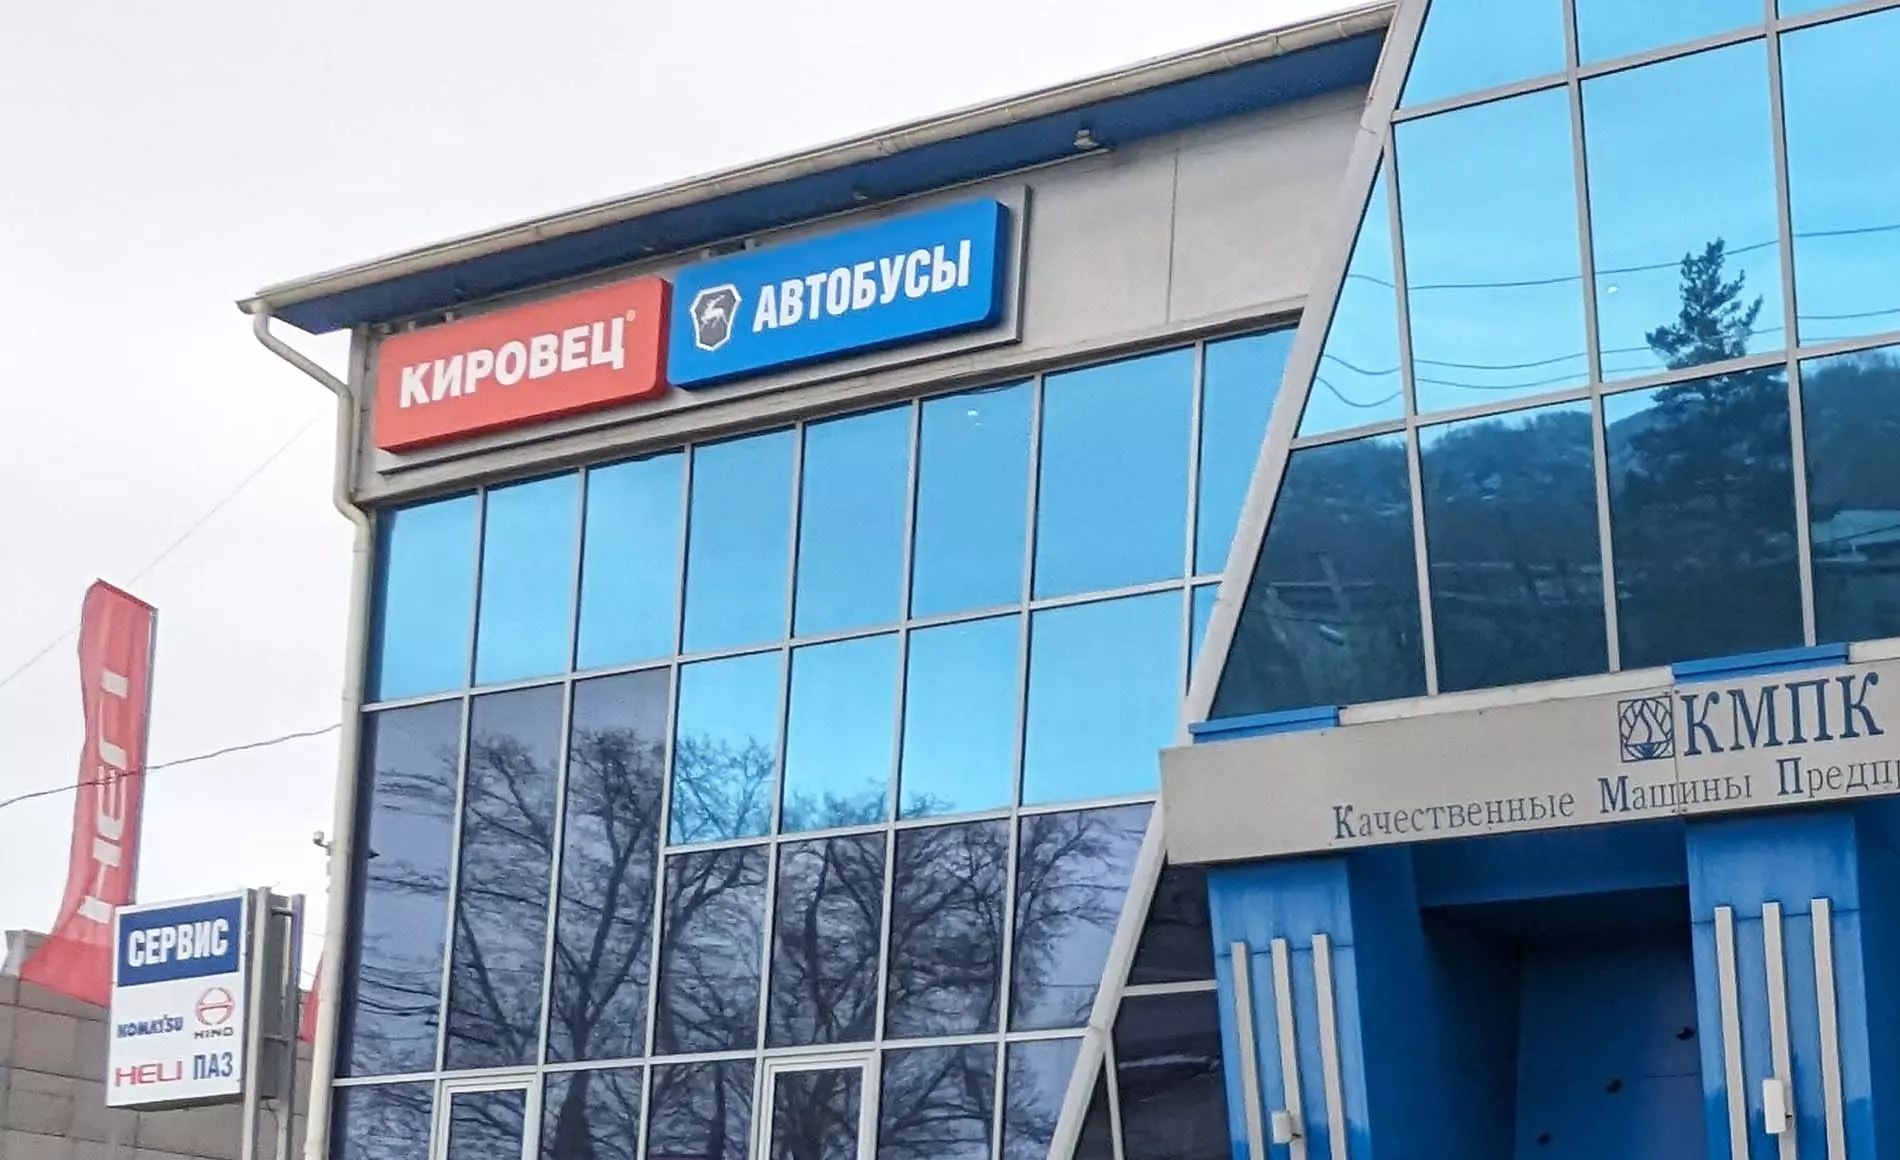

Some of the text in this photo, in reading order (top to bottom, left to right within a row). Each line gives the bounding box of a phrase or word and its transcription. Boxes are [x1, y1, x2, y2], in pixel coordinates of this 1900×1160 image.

[752, 239, 971, 333] АВТОБУСЫ
[400, 317, 624, 408] КИРОВЕЦ
[1680, 671, 1884, 757] КМПК
[1332, 789, 1575, 840] Качественные
[1597, 773, 1752, 815] Машины
[128, 918, 229, 967] СЕРВИС
[117, 1015, 183, 1038] KOMATSU
[194, 1027, 234, 1040] HINO
[115, 1061, 183, 1087] HELI
[193, 1052, 233, 1080] ПАЗ
